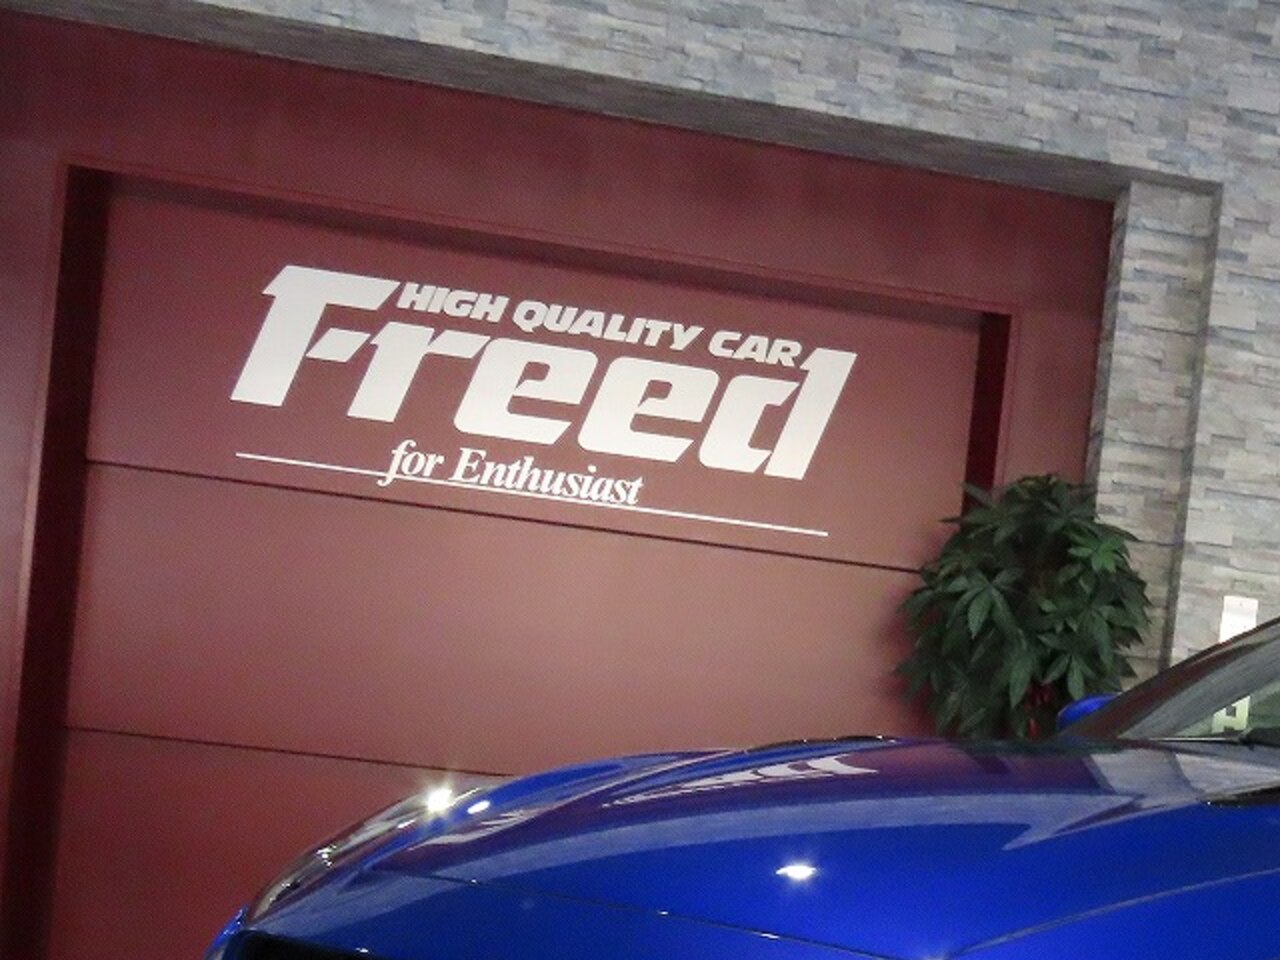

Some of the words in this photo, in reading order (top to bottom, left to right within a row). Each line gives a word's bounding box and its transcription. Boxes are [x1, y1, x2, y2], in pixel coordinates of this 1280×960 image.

[396, 282, 509, 323] HIGH
[512, 300, 703, 351] QUALITY
[708, 330, 802, 367] CAR
[230, 265, 858, 481] Freed
[377, 439, 444, 487] for
[448, 446, 643, 505] Enthusiast
